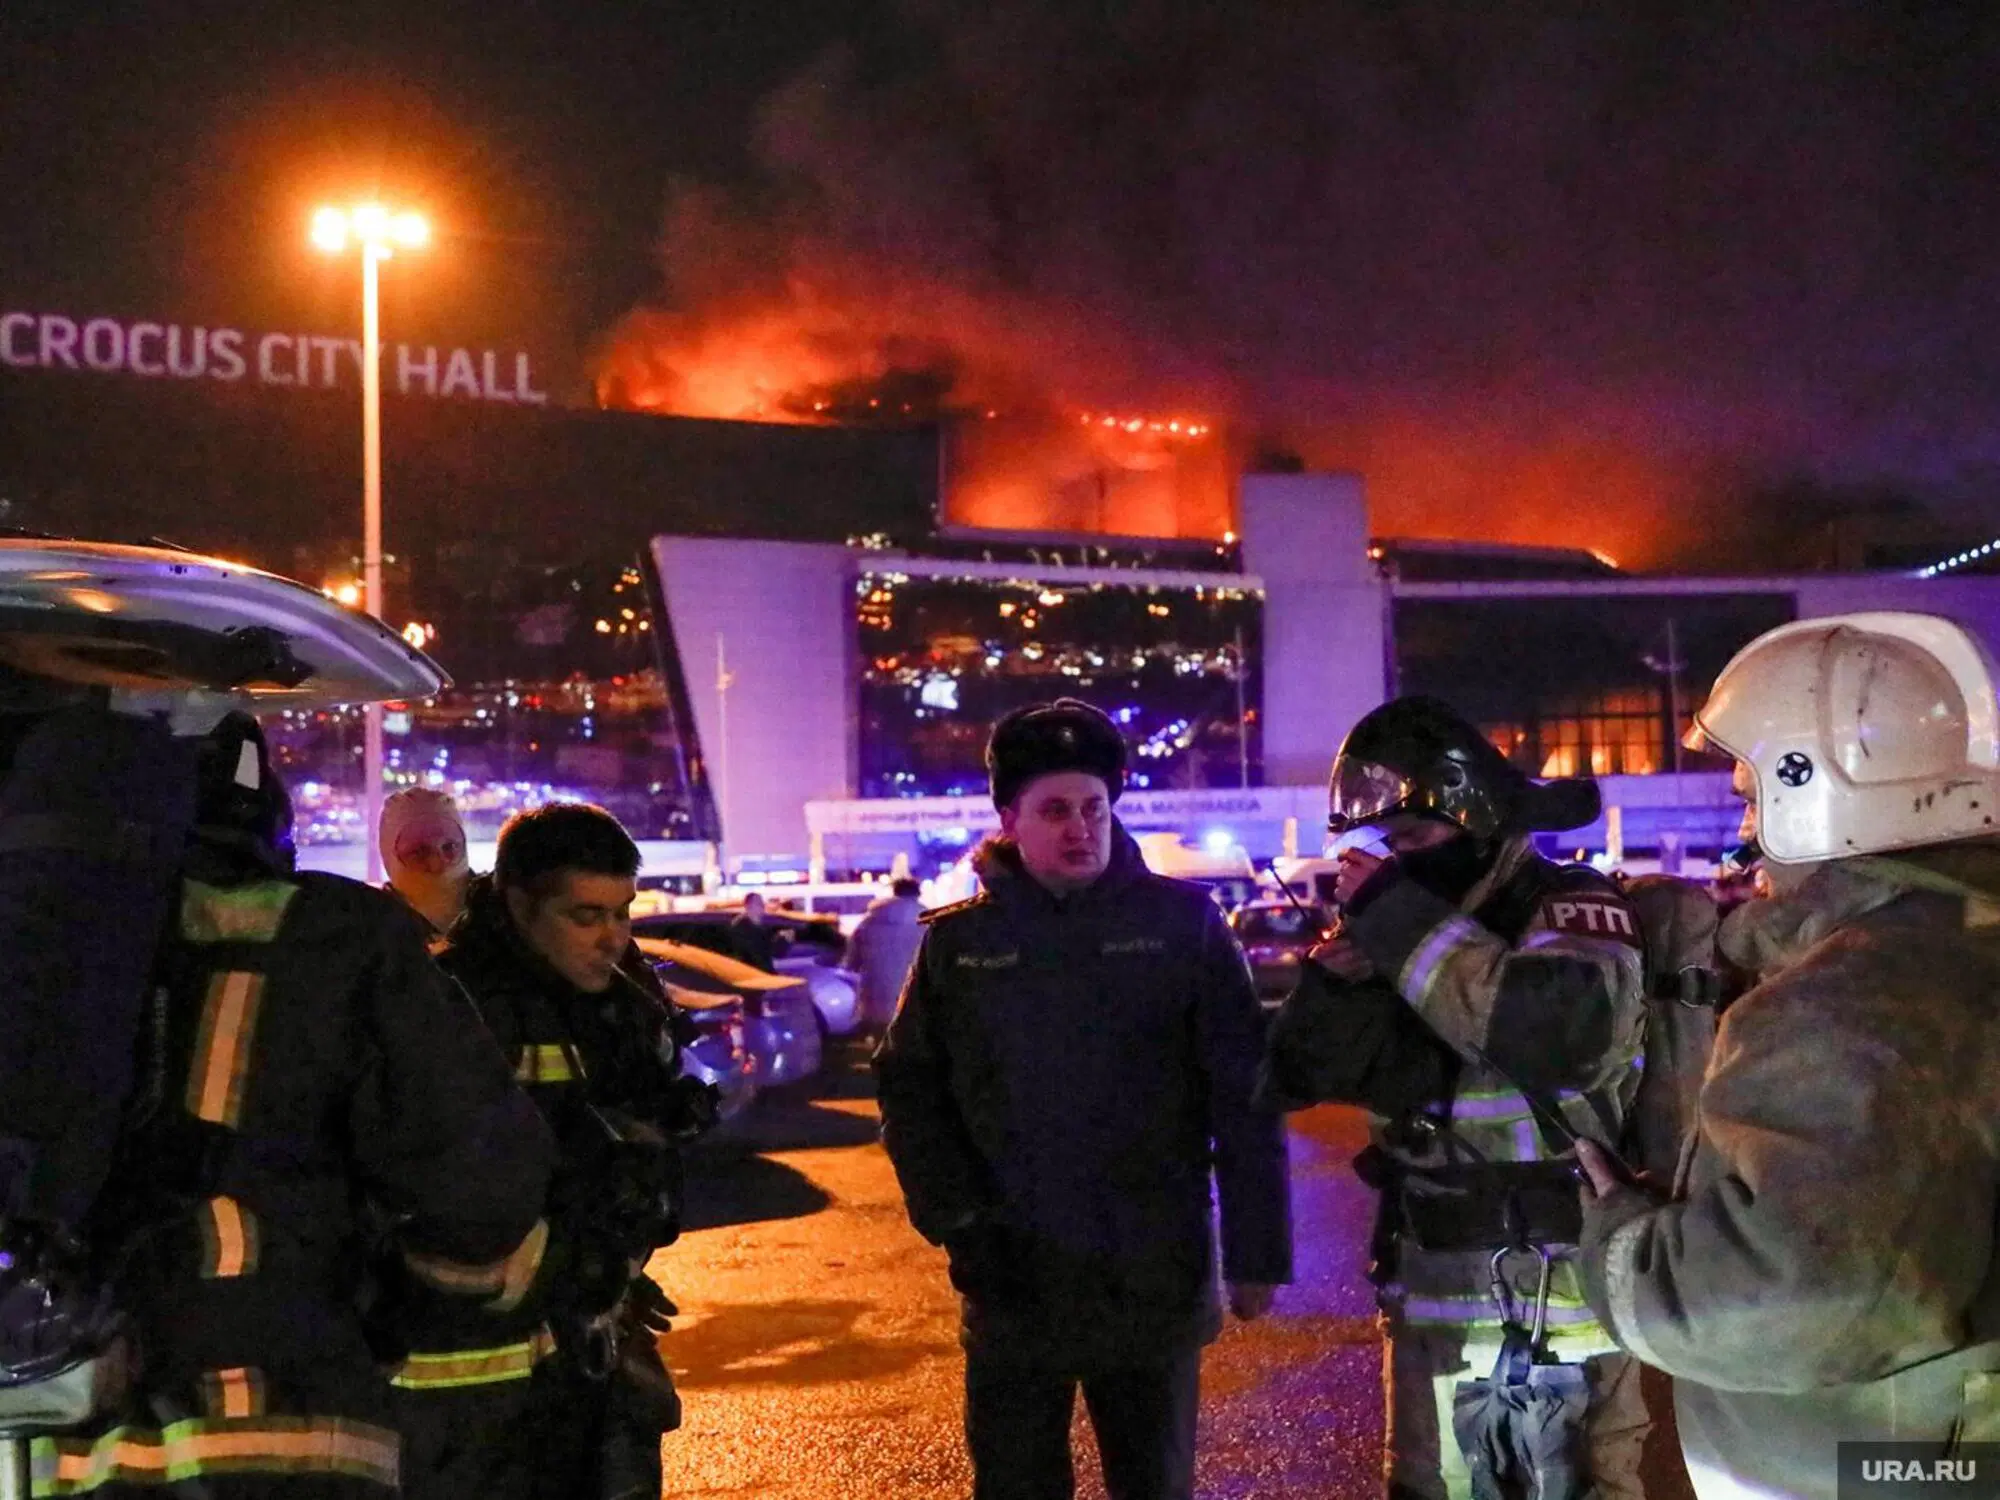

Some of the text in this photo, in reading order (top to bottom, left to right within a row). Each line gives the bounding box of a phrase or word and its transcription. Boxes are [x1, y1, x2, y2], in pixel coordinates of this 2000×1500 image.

[0, 313, 246, 380] CROCUS
[397, 344, 547, 405] HALL
[1552, 902, 1634, 935] РТП
